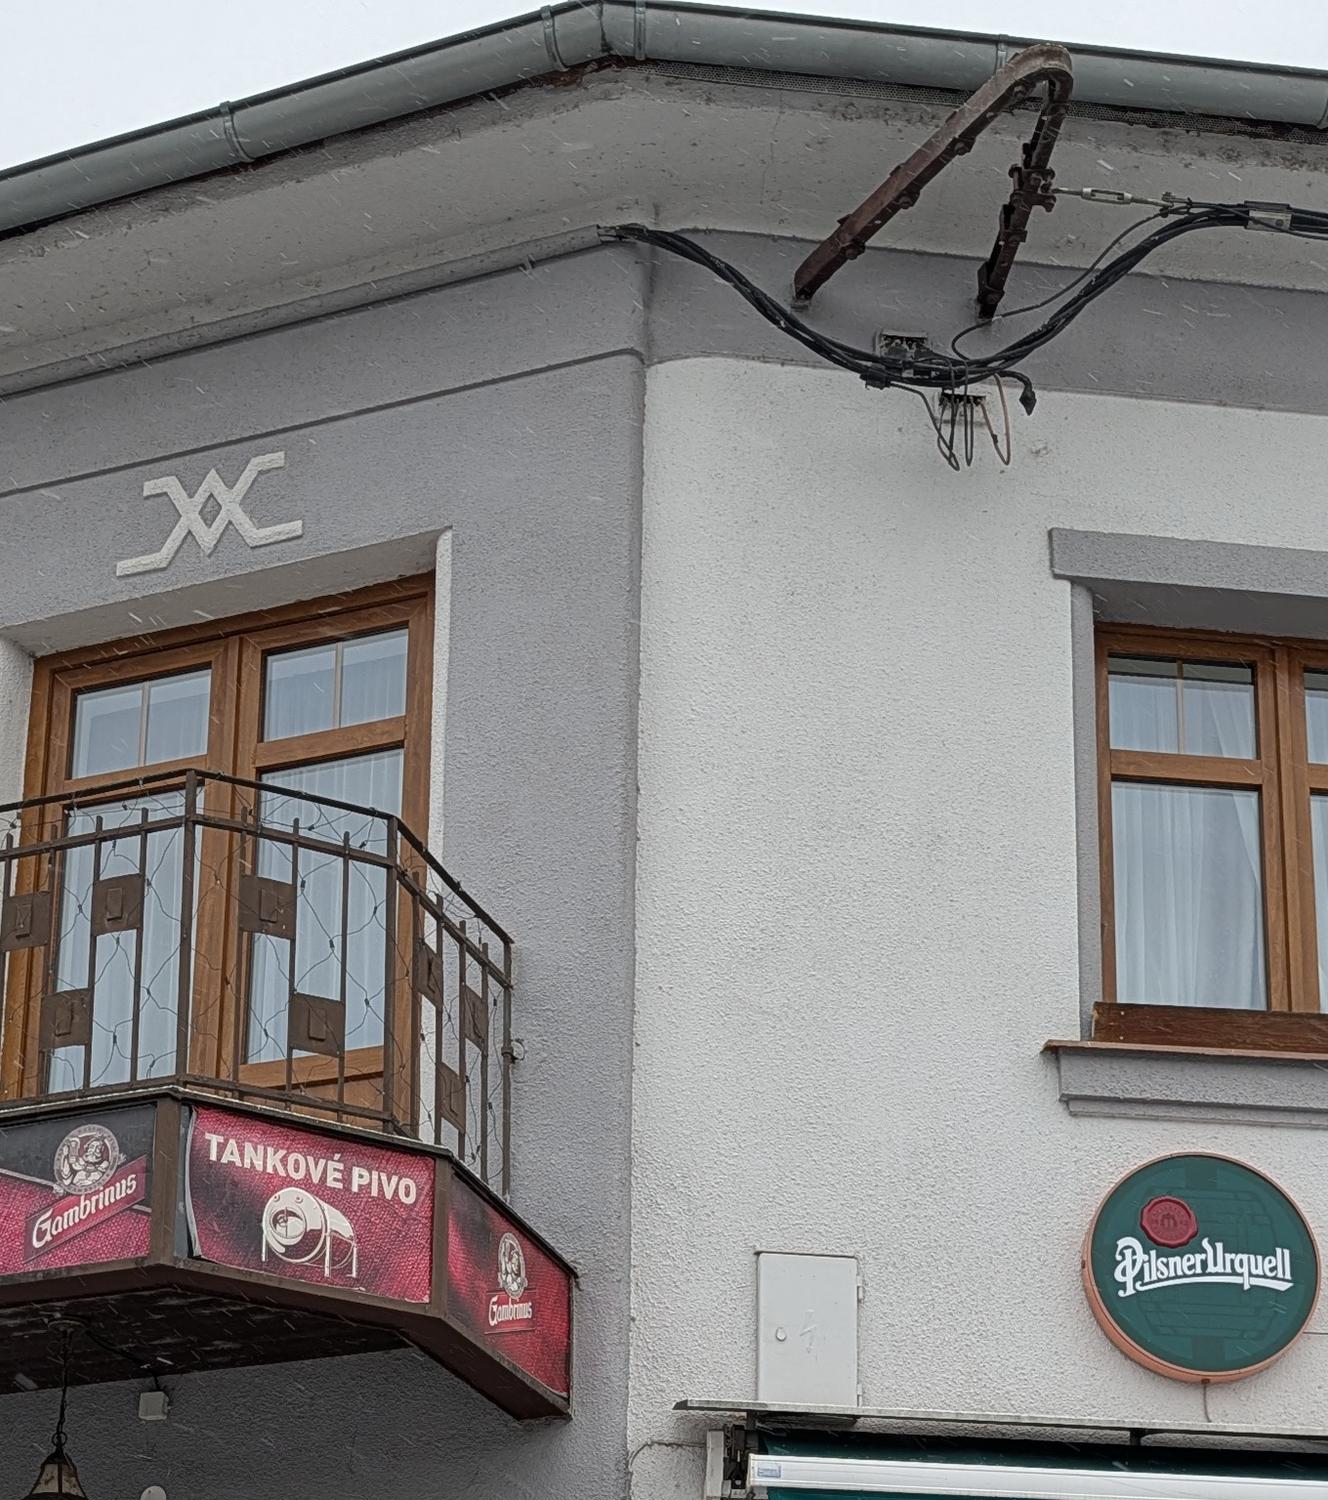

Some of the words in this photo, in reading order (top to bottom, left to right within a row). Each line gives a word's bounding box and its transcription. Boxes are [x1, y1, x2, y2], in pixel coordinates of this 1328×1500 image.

[205, 1132, 345, 1190] TANKOVÉ
[351, 1166, 417, 1205] PIVO
[32, 1173, 137, 1249] Gambrinus
[1113, 1236, 1207, 1298] Pilsner
[1202, 1237, 1292, 1290] Urquell
